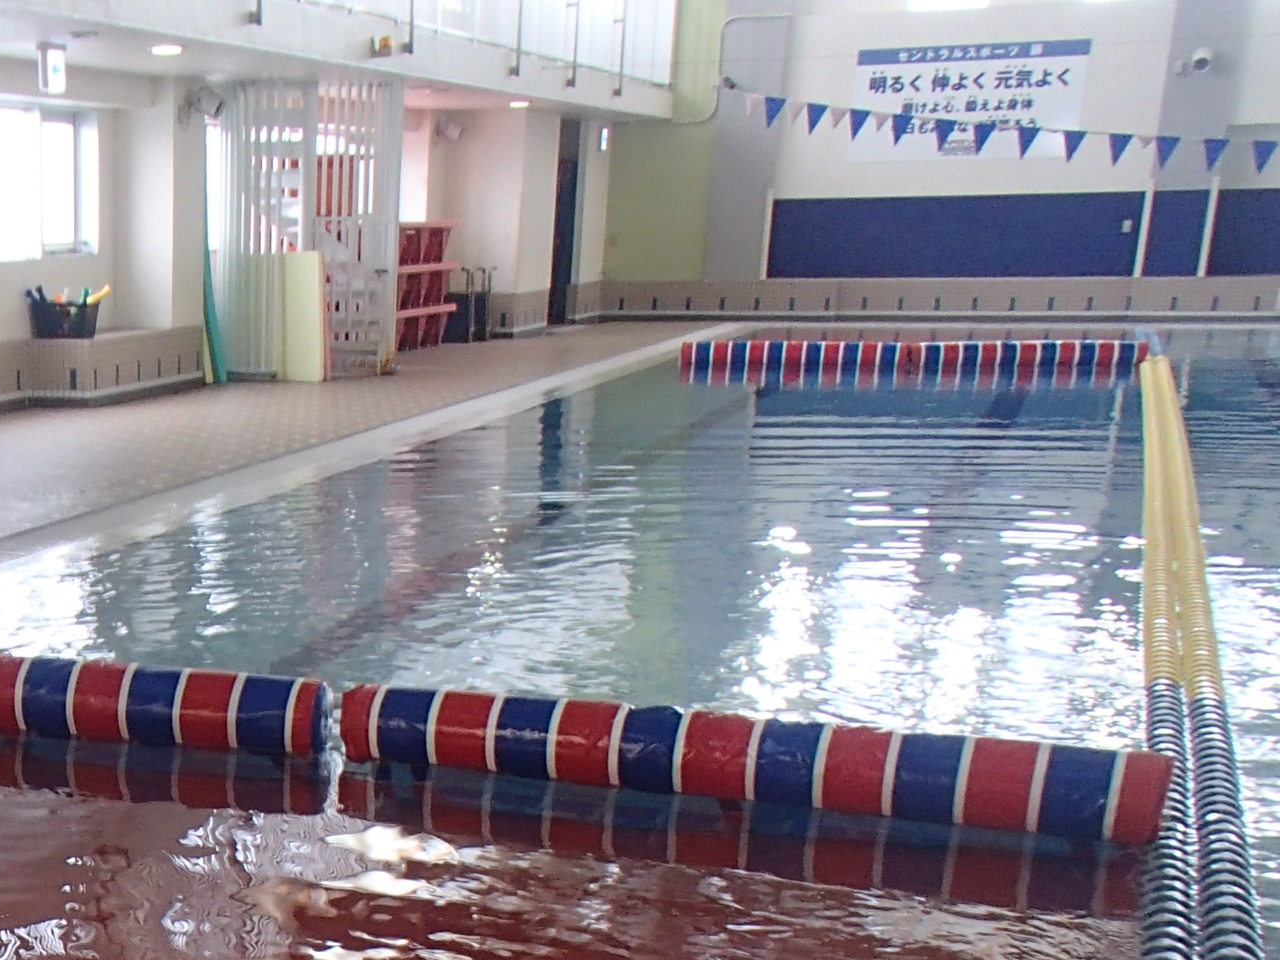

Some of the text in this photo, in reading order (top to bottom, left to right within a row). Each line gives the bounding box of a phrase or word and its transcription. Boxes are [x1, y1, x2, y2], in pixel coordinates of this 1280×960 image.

[898, 44, 1020, 62] セントラルスポーツ
[868, 68, 1071, 94] 明るく 仲よく 元気よく
